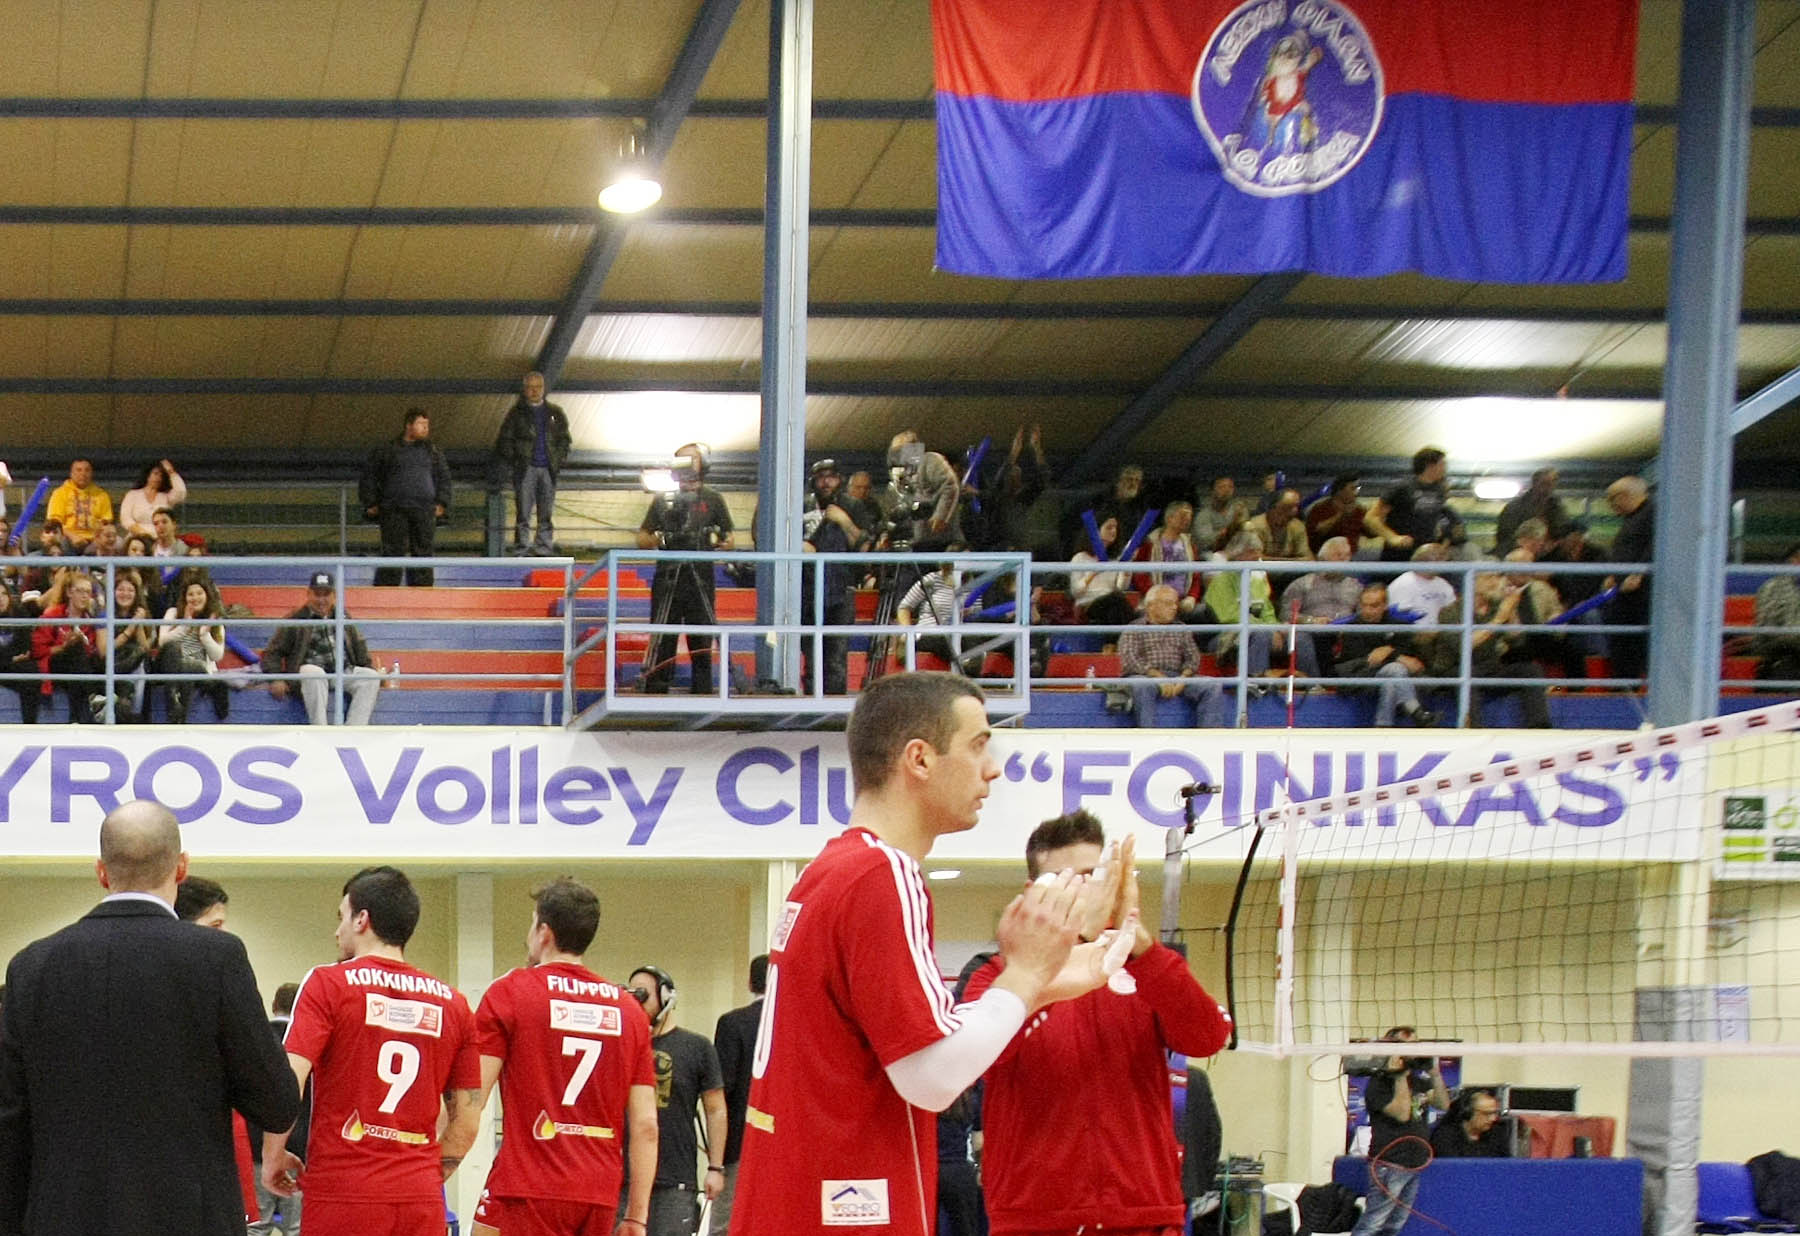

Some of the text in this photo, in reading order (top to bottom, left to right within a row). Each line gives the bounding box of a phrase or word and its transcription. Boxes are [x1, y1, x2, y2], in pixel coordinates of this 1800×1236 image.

[337, 743, 684, 847] Volley
[345, 969, 453, 1000] KOKKINAKIS
[547, 975, 620, 1000] FILIPPOV
[376, 1040, 420, 1114] 9
[561, 1036, 602, 1106] 7
